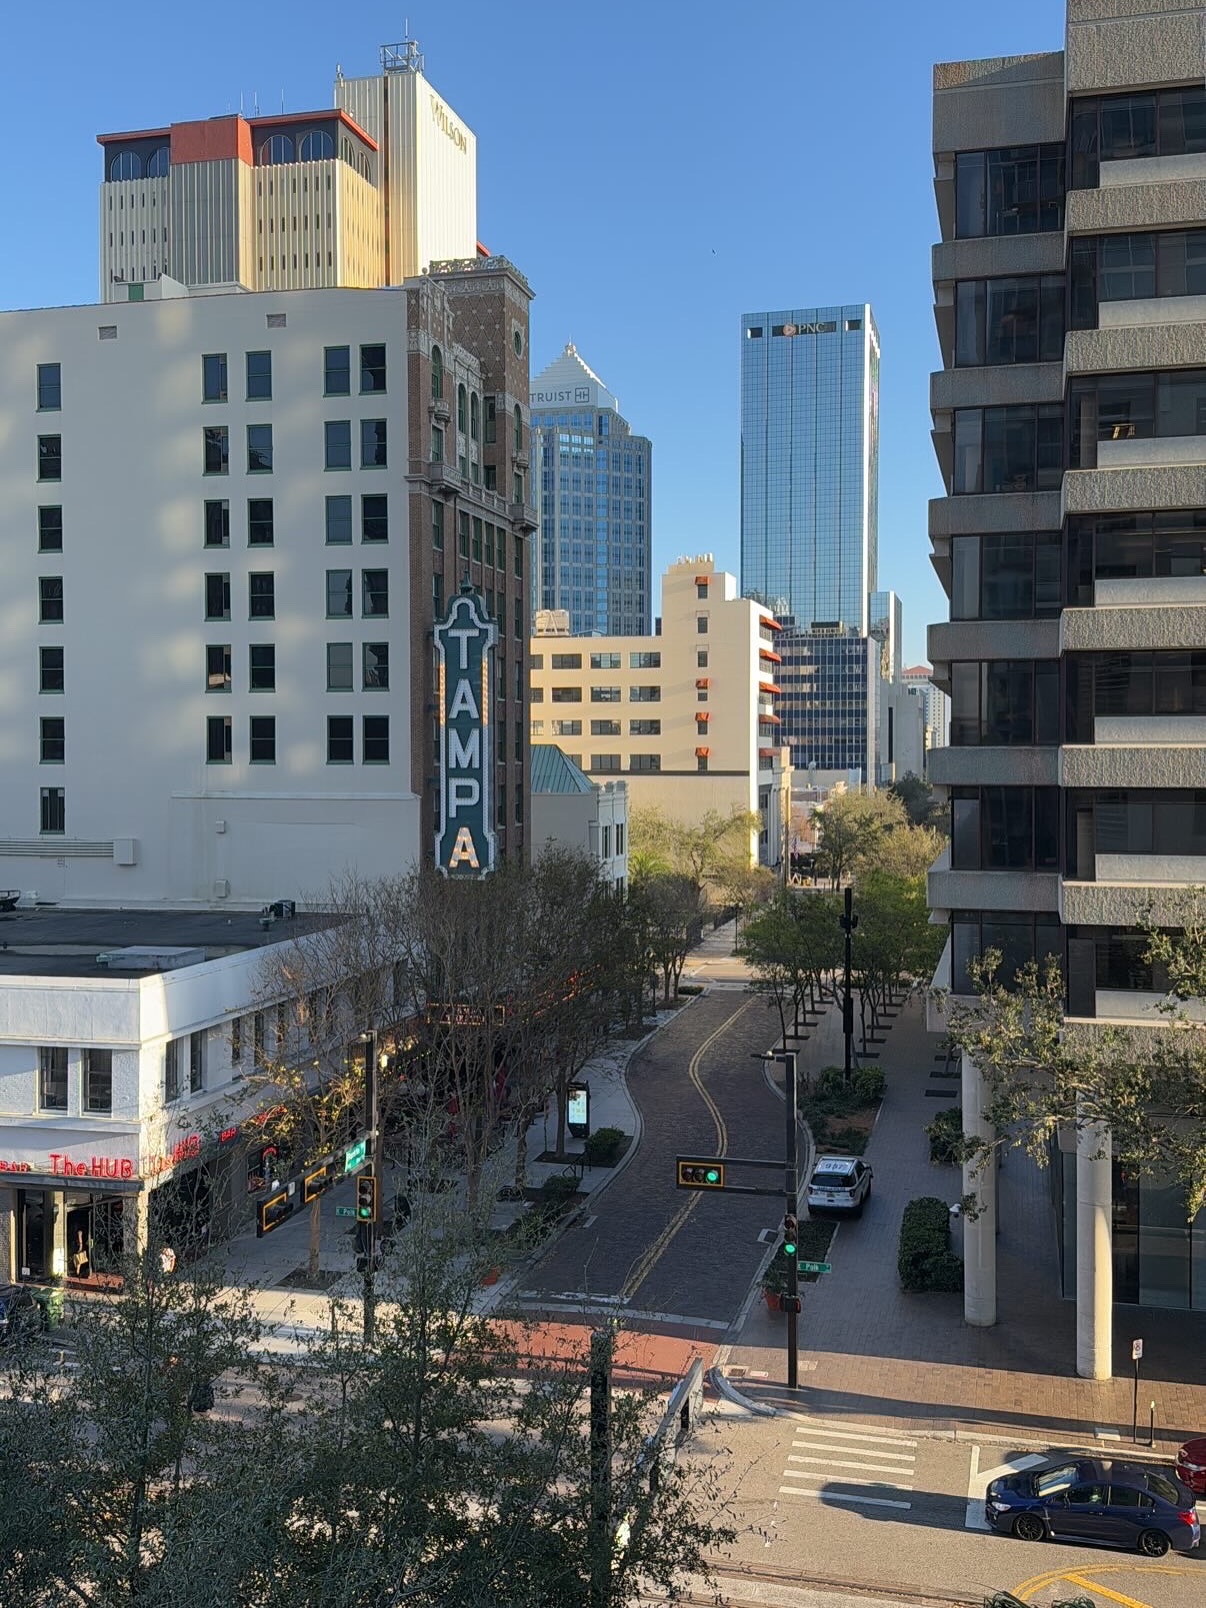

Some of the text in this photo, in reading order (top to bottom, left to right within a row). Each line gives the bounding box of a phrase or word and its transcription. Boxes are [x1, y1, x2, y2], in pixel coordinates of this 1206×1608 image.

[429, 94, 467, 154] WILSON
[798, 322, 825, 334] PNC
[529, 391, 572, 403] TRUIST
[447, 628, 480, 869] TAMPA
[48, 1152, 133, 1179] The HUB
